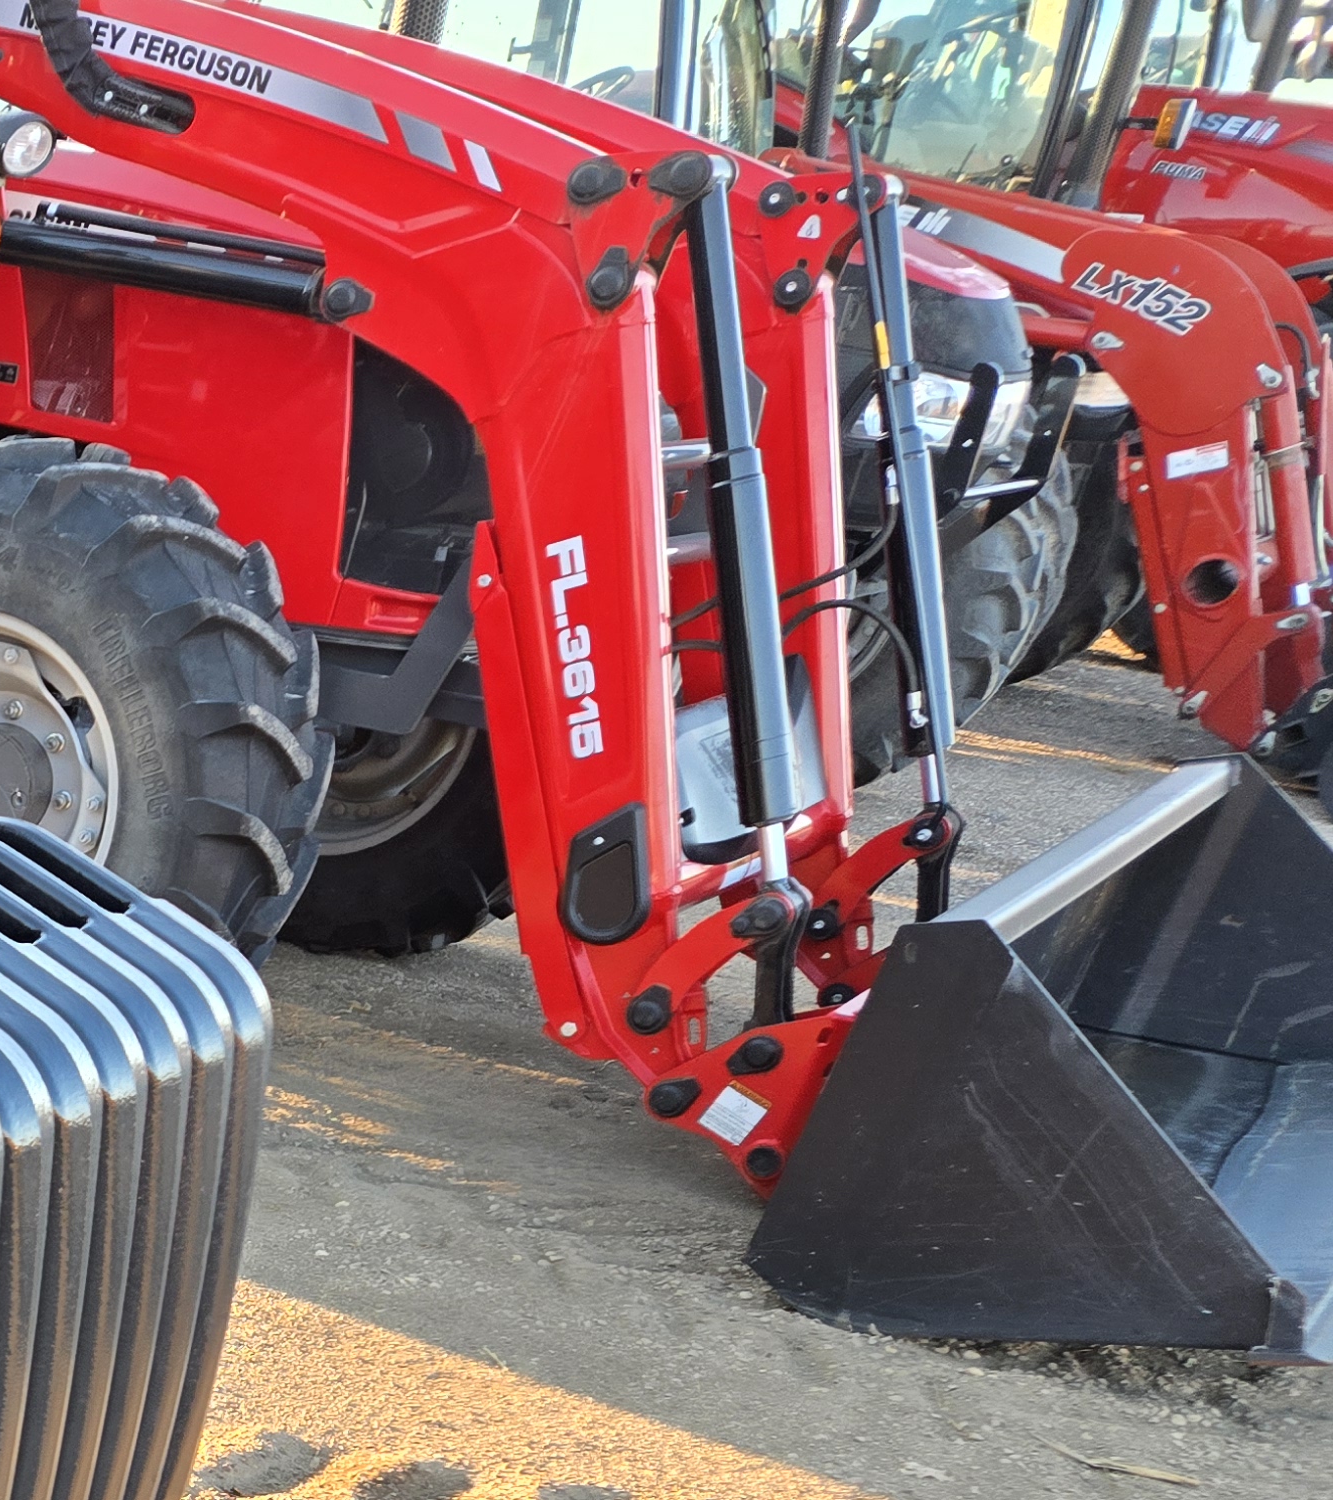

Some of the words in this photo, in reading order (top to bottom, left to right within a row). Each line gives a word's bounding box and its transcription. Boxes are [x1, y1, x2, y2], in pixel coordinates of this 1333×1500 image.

[18, 3, 127, 50] MEY
[129, 30, 273, 95] FERGUSON
[1151, 160, 1207, 182] PUMA
[1071, 262, 1212, 336] LX152
[546, 535, 604, 760] FL.3615
[91, 612, 174, 821] TRELLEBORG
